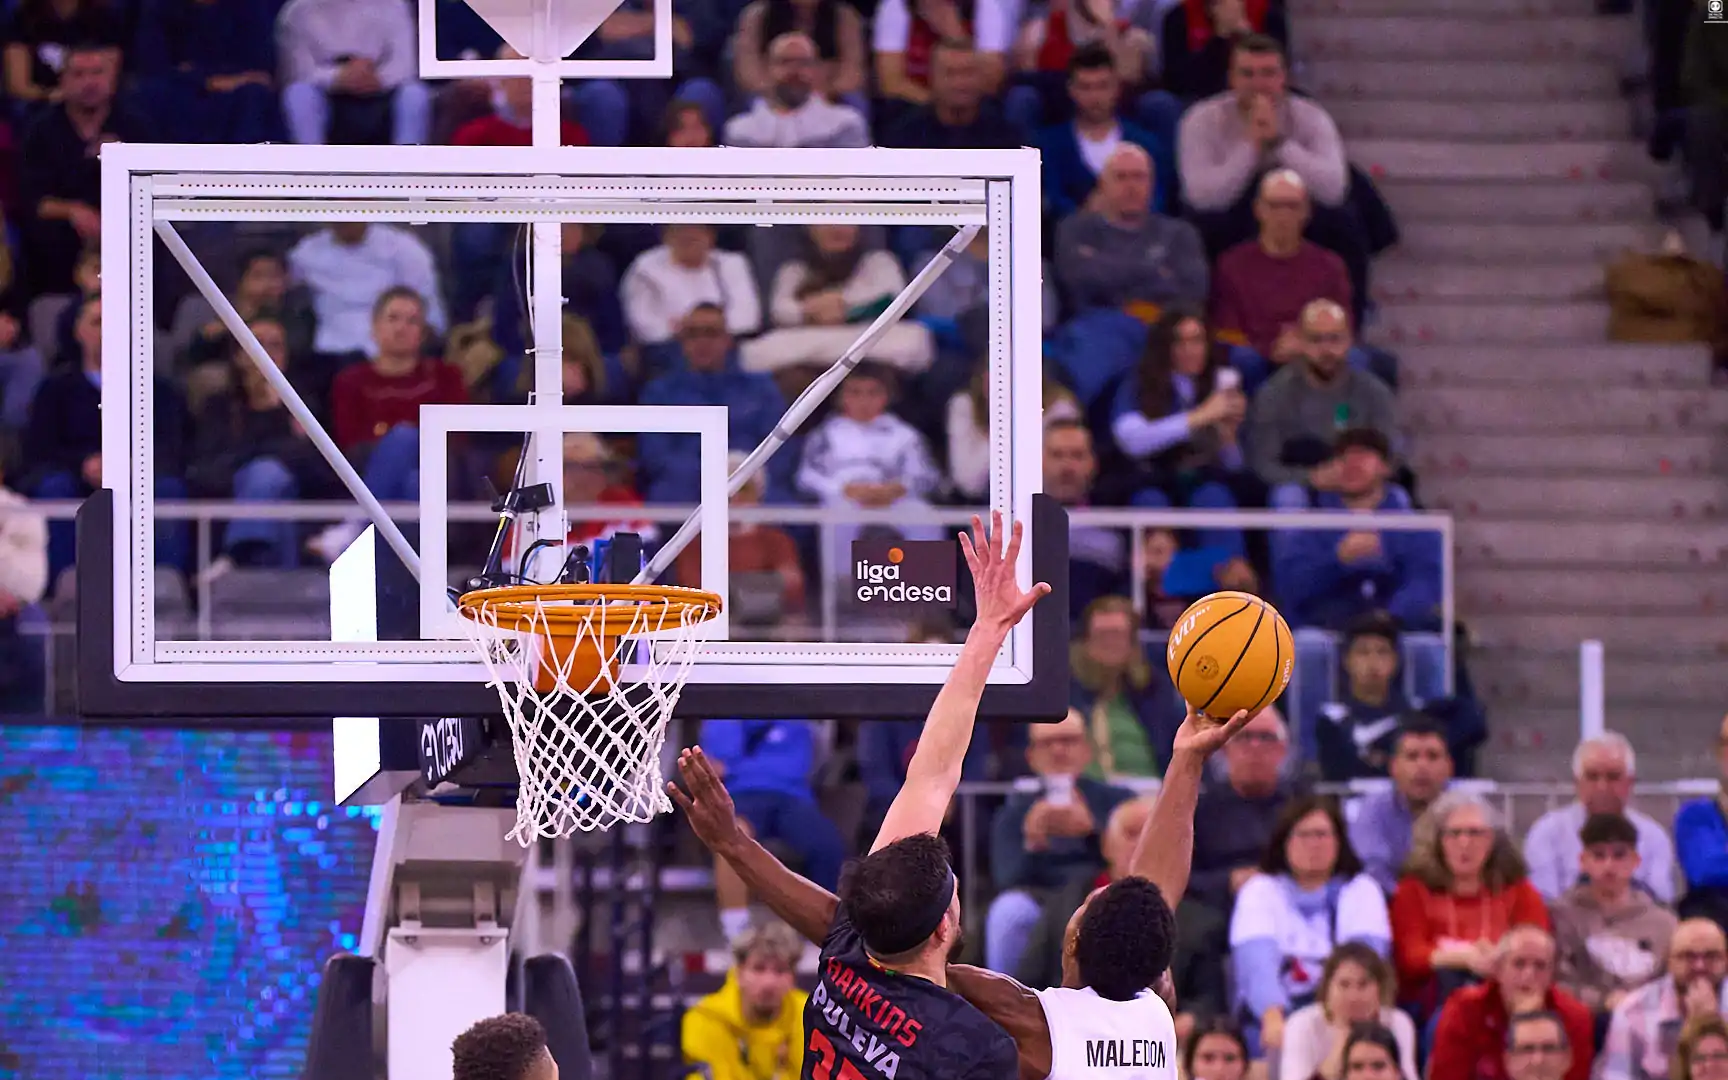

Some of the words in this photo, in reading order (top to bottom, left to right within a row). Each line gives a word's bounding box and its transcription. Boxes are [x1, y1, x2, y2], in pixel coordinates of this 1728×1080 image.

[857, 560, 900, 584] liga
[857, 582, 951, 602] endesa
[826, 956, 923, 1048] HANKINS
[812, 980, 900, 1080] PULEVA
[1086, 1039, 1166, 1068] MALEDON
